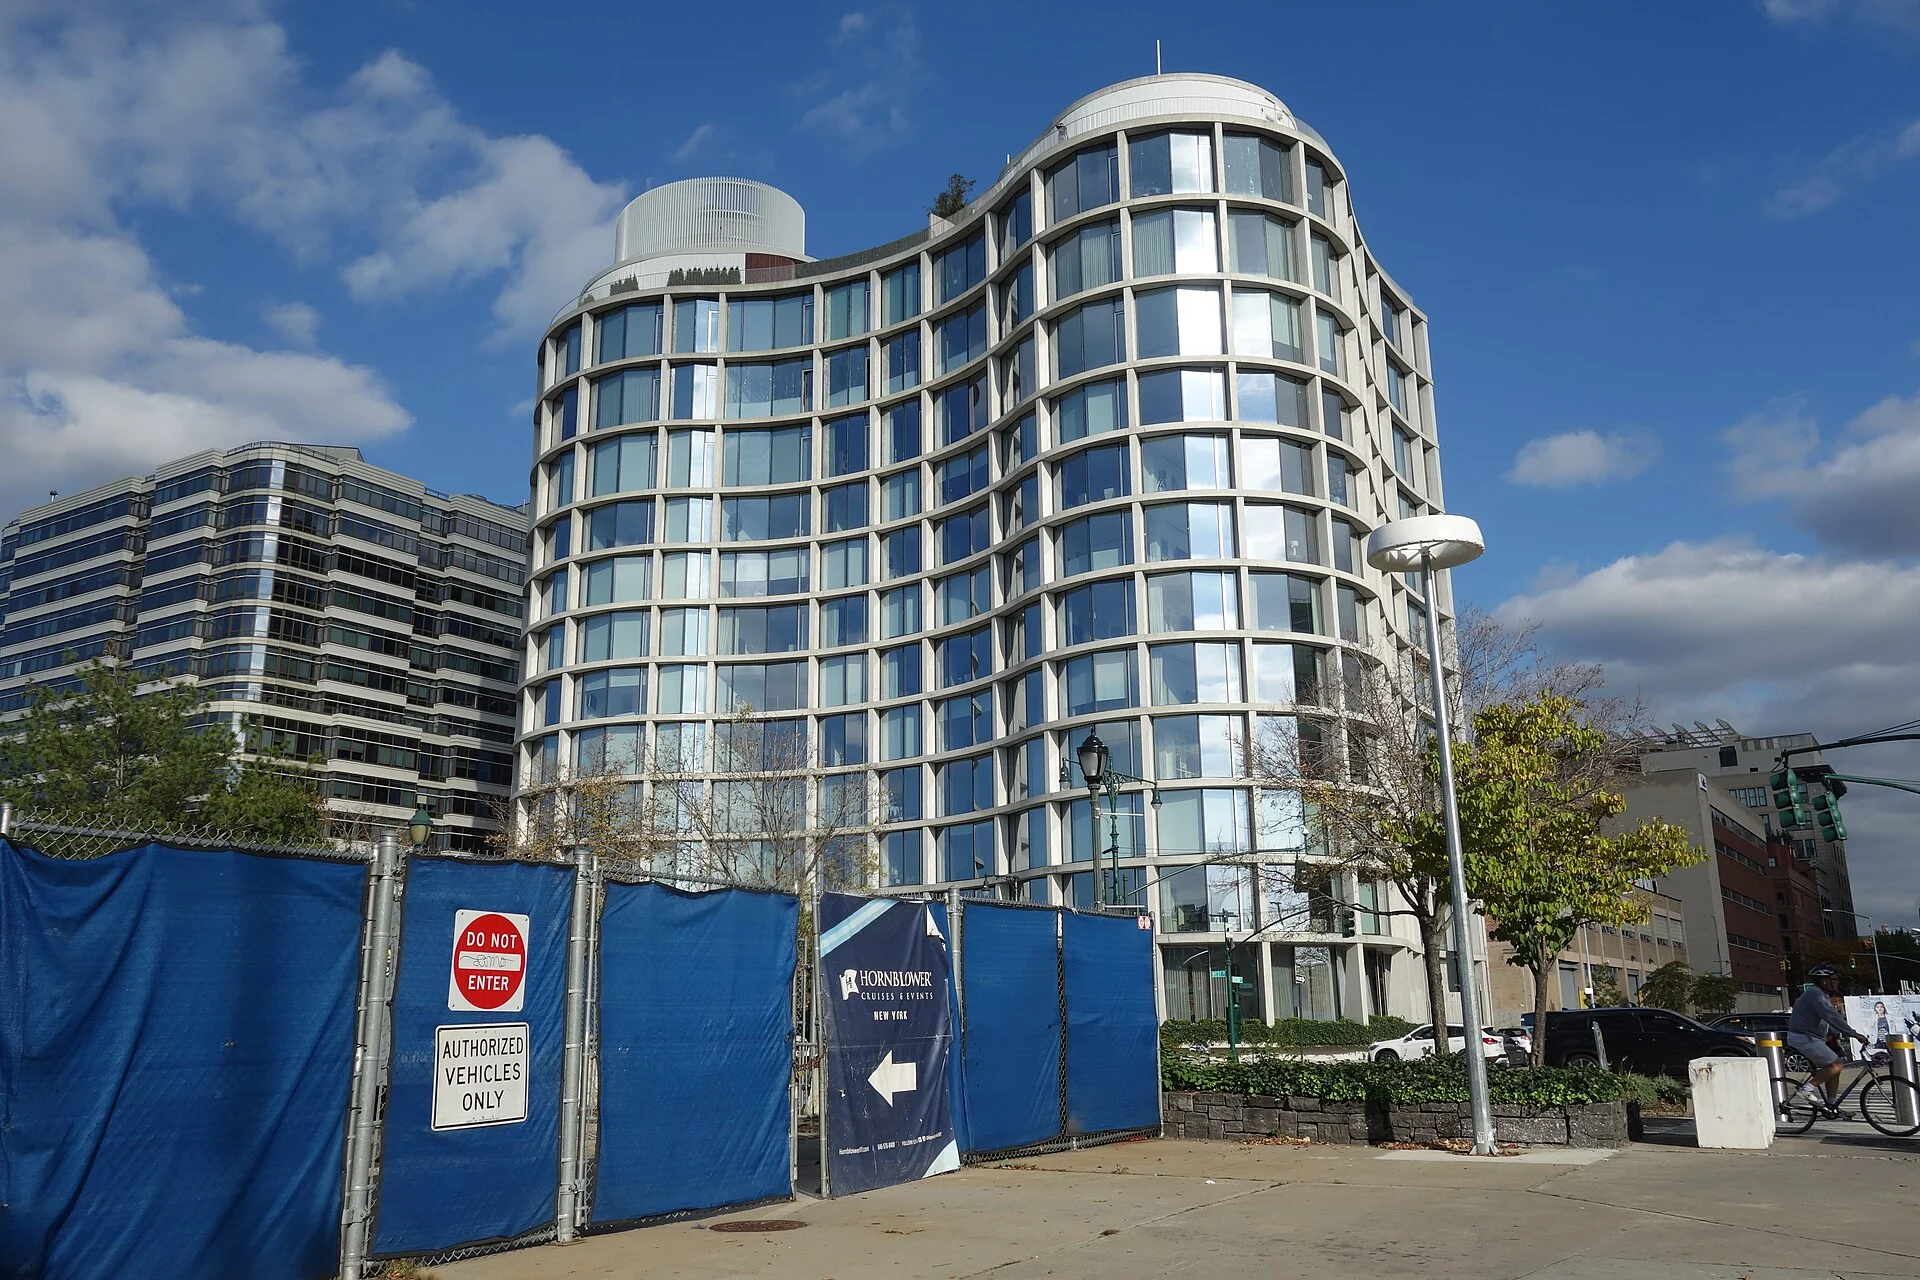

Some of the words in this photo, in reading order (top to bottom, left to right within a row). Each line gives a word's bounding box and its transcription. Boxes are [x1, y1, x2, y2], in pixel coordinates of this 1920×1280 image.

[467, 931, 485, 947] DO
[491, 933, 517, 948] NOT
[468, 975, 509, 991] ENTER
[860, 970, 932, 987] HORNBLOWER
[861, 992, 895, 1000] CRUISES
[906, 992, 933, 1000] EVENTS
[873, 1010, 889, 1021] NEW
[892, 1010, 908, 1020] YORK
[443, 1037, 523, 1059] AUTHORIZED
[445, 1062, 521, 1086] VEHICLES
[462, 1090, 504, 1111] ONLY
